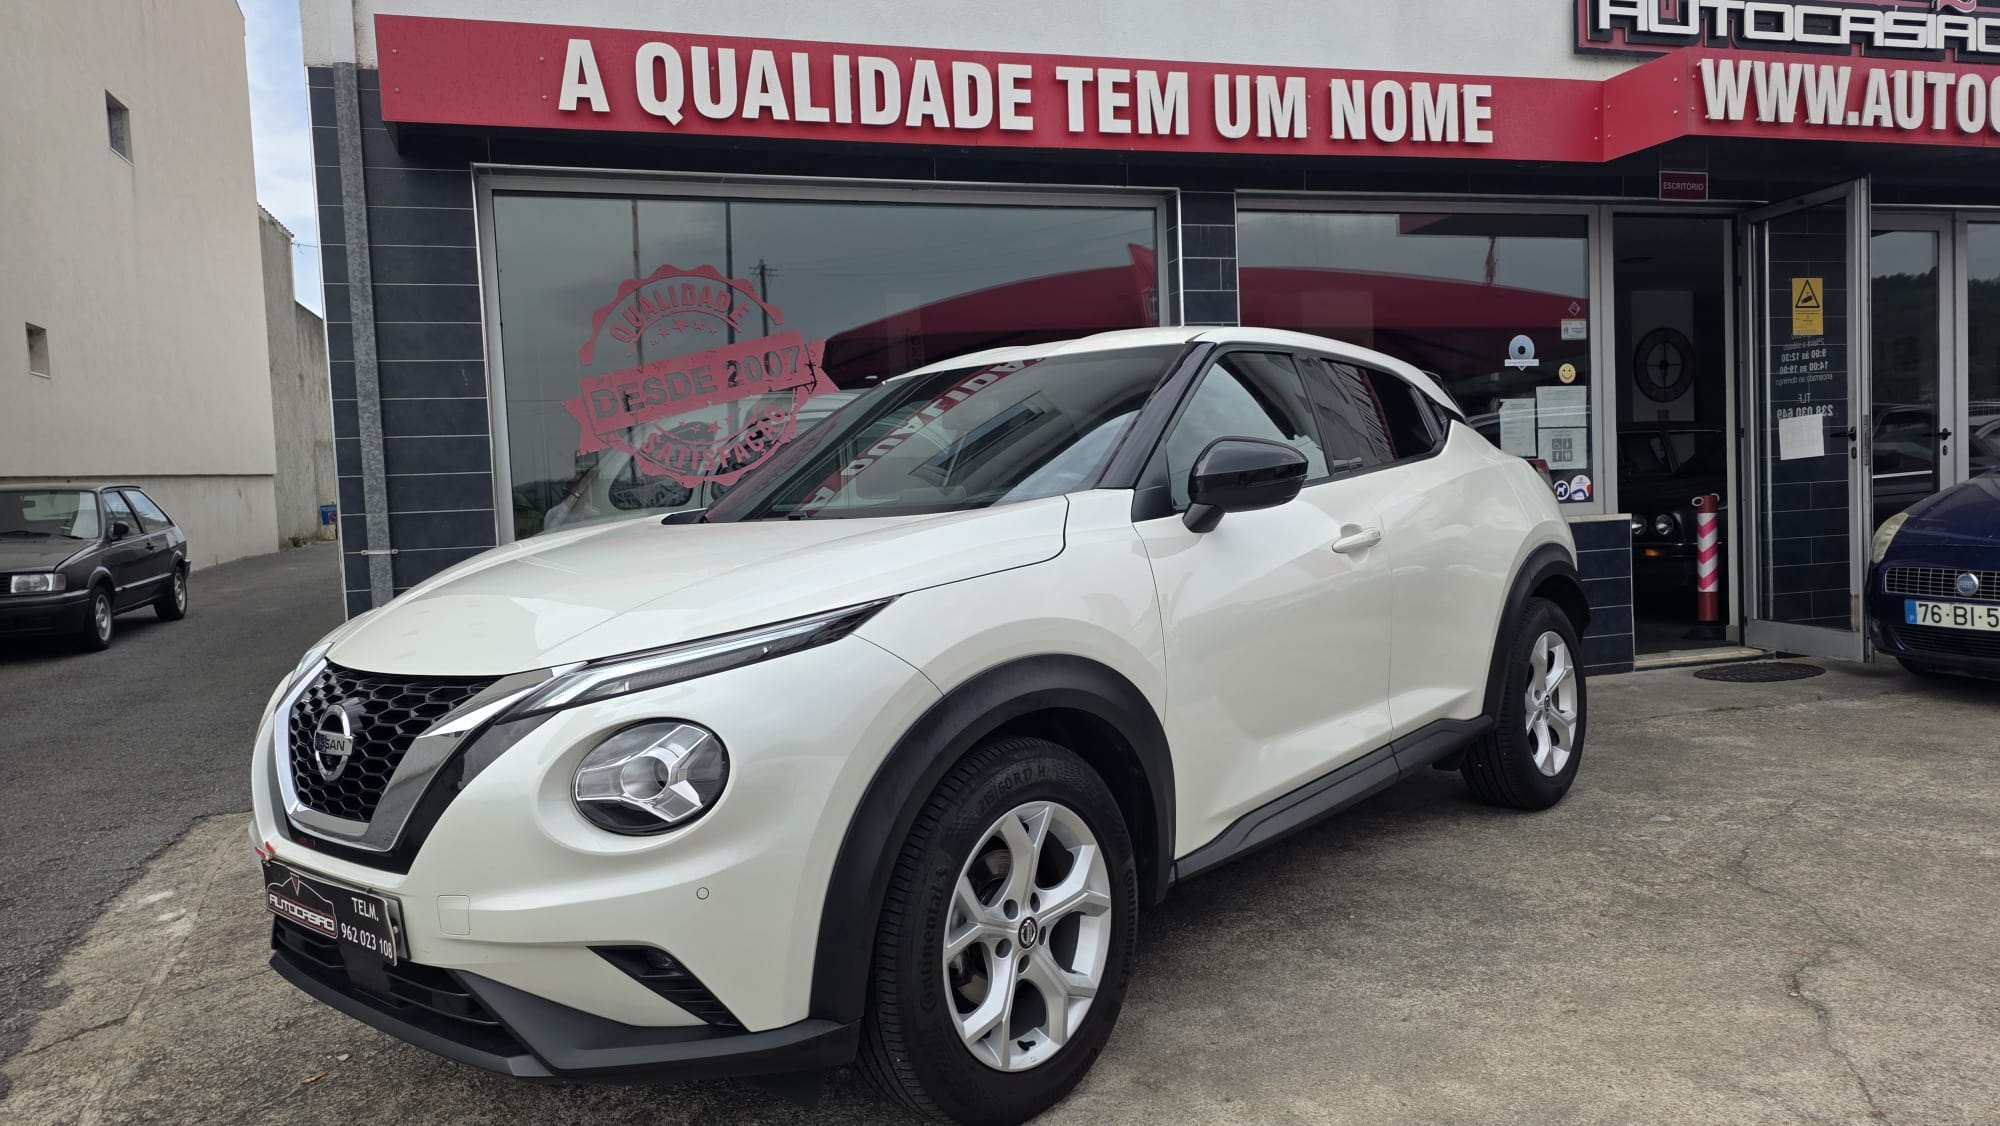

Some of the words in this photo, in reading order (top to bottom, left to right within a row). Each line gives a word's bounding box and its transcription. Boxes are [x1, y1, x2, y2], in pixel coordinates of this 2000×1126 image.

[558, 38, 611, 113] A
[634, 41, 1034, 132] QUALIDADE
[1055, 66, 1190, 136] TEM
[1213, 73, 1308, 140] UM
[1330, 78, 1494, 144] NOME
[609, 282, 750, 343] QUALIDADE
[590, 365, 718, 419] DESDE
[723, 345, 801, 388] 2007
[351, 896, 379, 922] TELM.
[340, 922, 359, 944] 962
[359, 930, 377, 951] 023
[379, 938, 393, 960] 108
